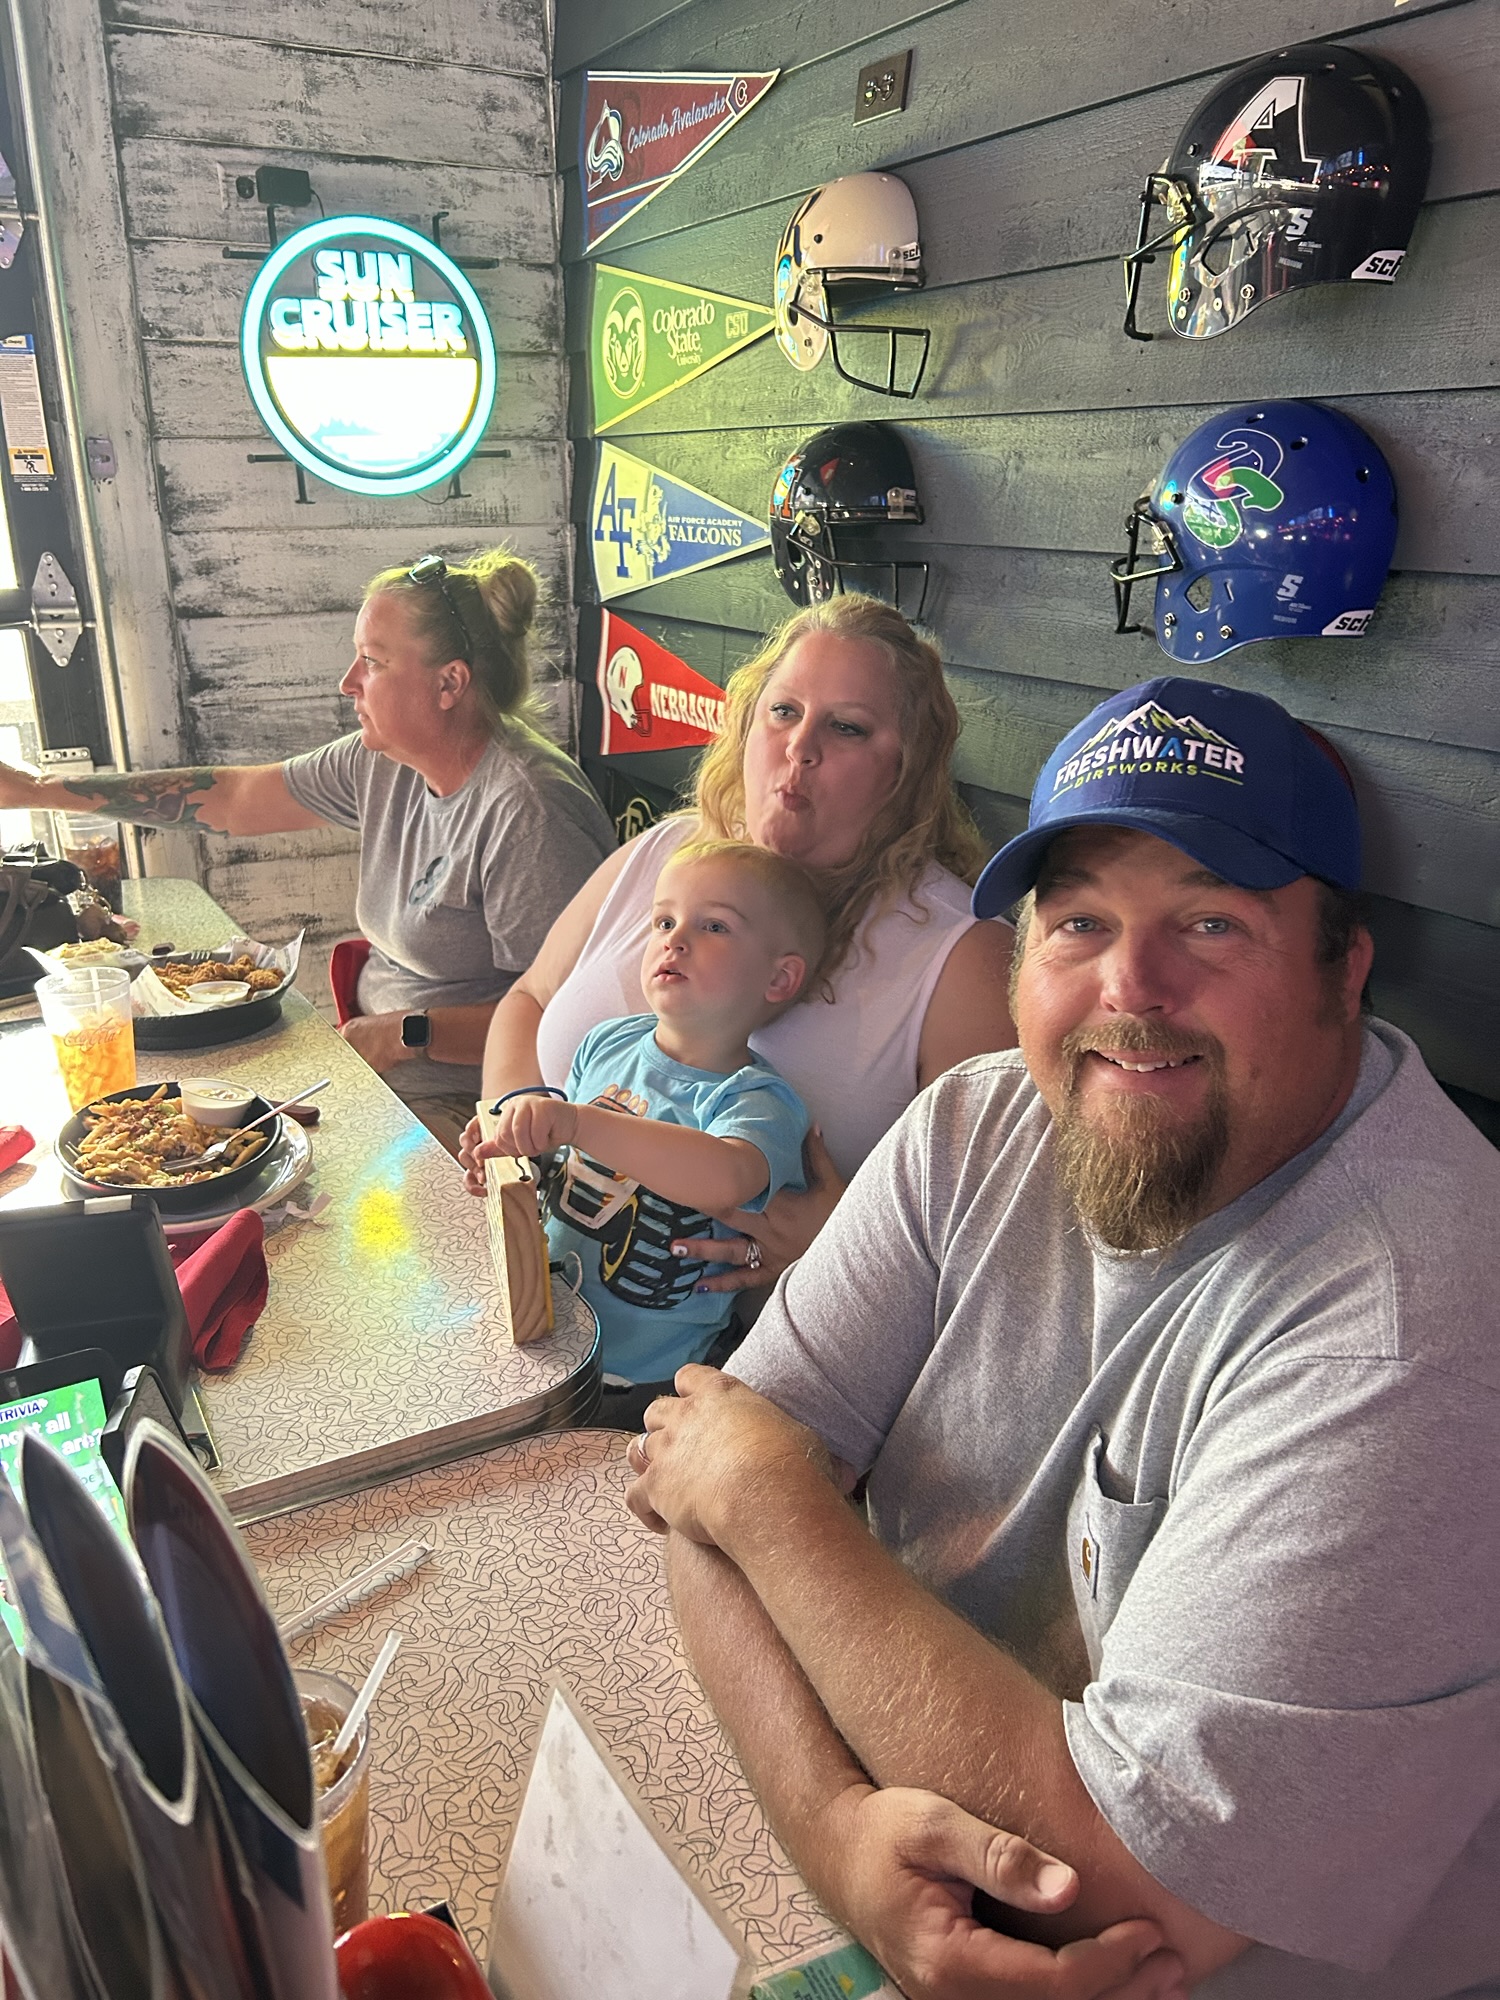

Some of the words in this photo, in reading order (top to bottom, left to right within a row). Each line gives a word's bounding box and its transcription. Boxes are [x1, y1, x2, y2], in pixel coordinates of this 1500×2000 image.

[627, 113, 669, 153] Colorado
[669, 91, 726, 137] Avalanche
[314, 249, 415, 303] SUN
[269, 297, 468, 352] CRUISER
[652, 299, 715, 334] Colorado
[725, 310, 749, 339] CSU
[666, 328, 702, 359] State
[667, 516, 681, 524] AIR
[681, 516, 705, 525] FORCE
[706, 518, 743, 527] ACADEMY
[667, 524, 742, 547] FALCONS
[650, 682, 726, 735] NEBRASKA
[1053, 735, 1245, 791] FRESHWATER
[1074, 761, 1198, 789] DIRTWORKS
[45, 1411, 71, 1434] all
